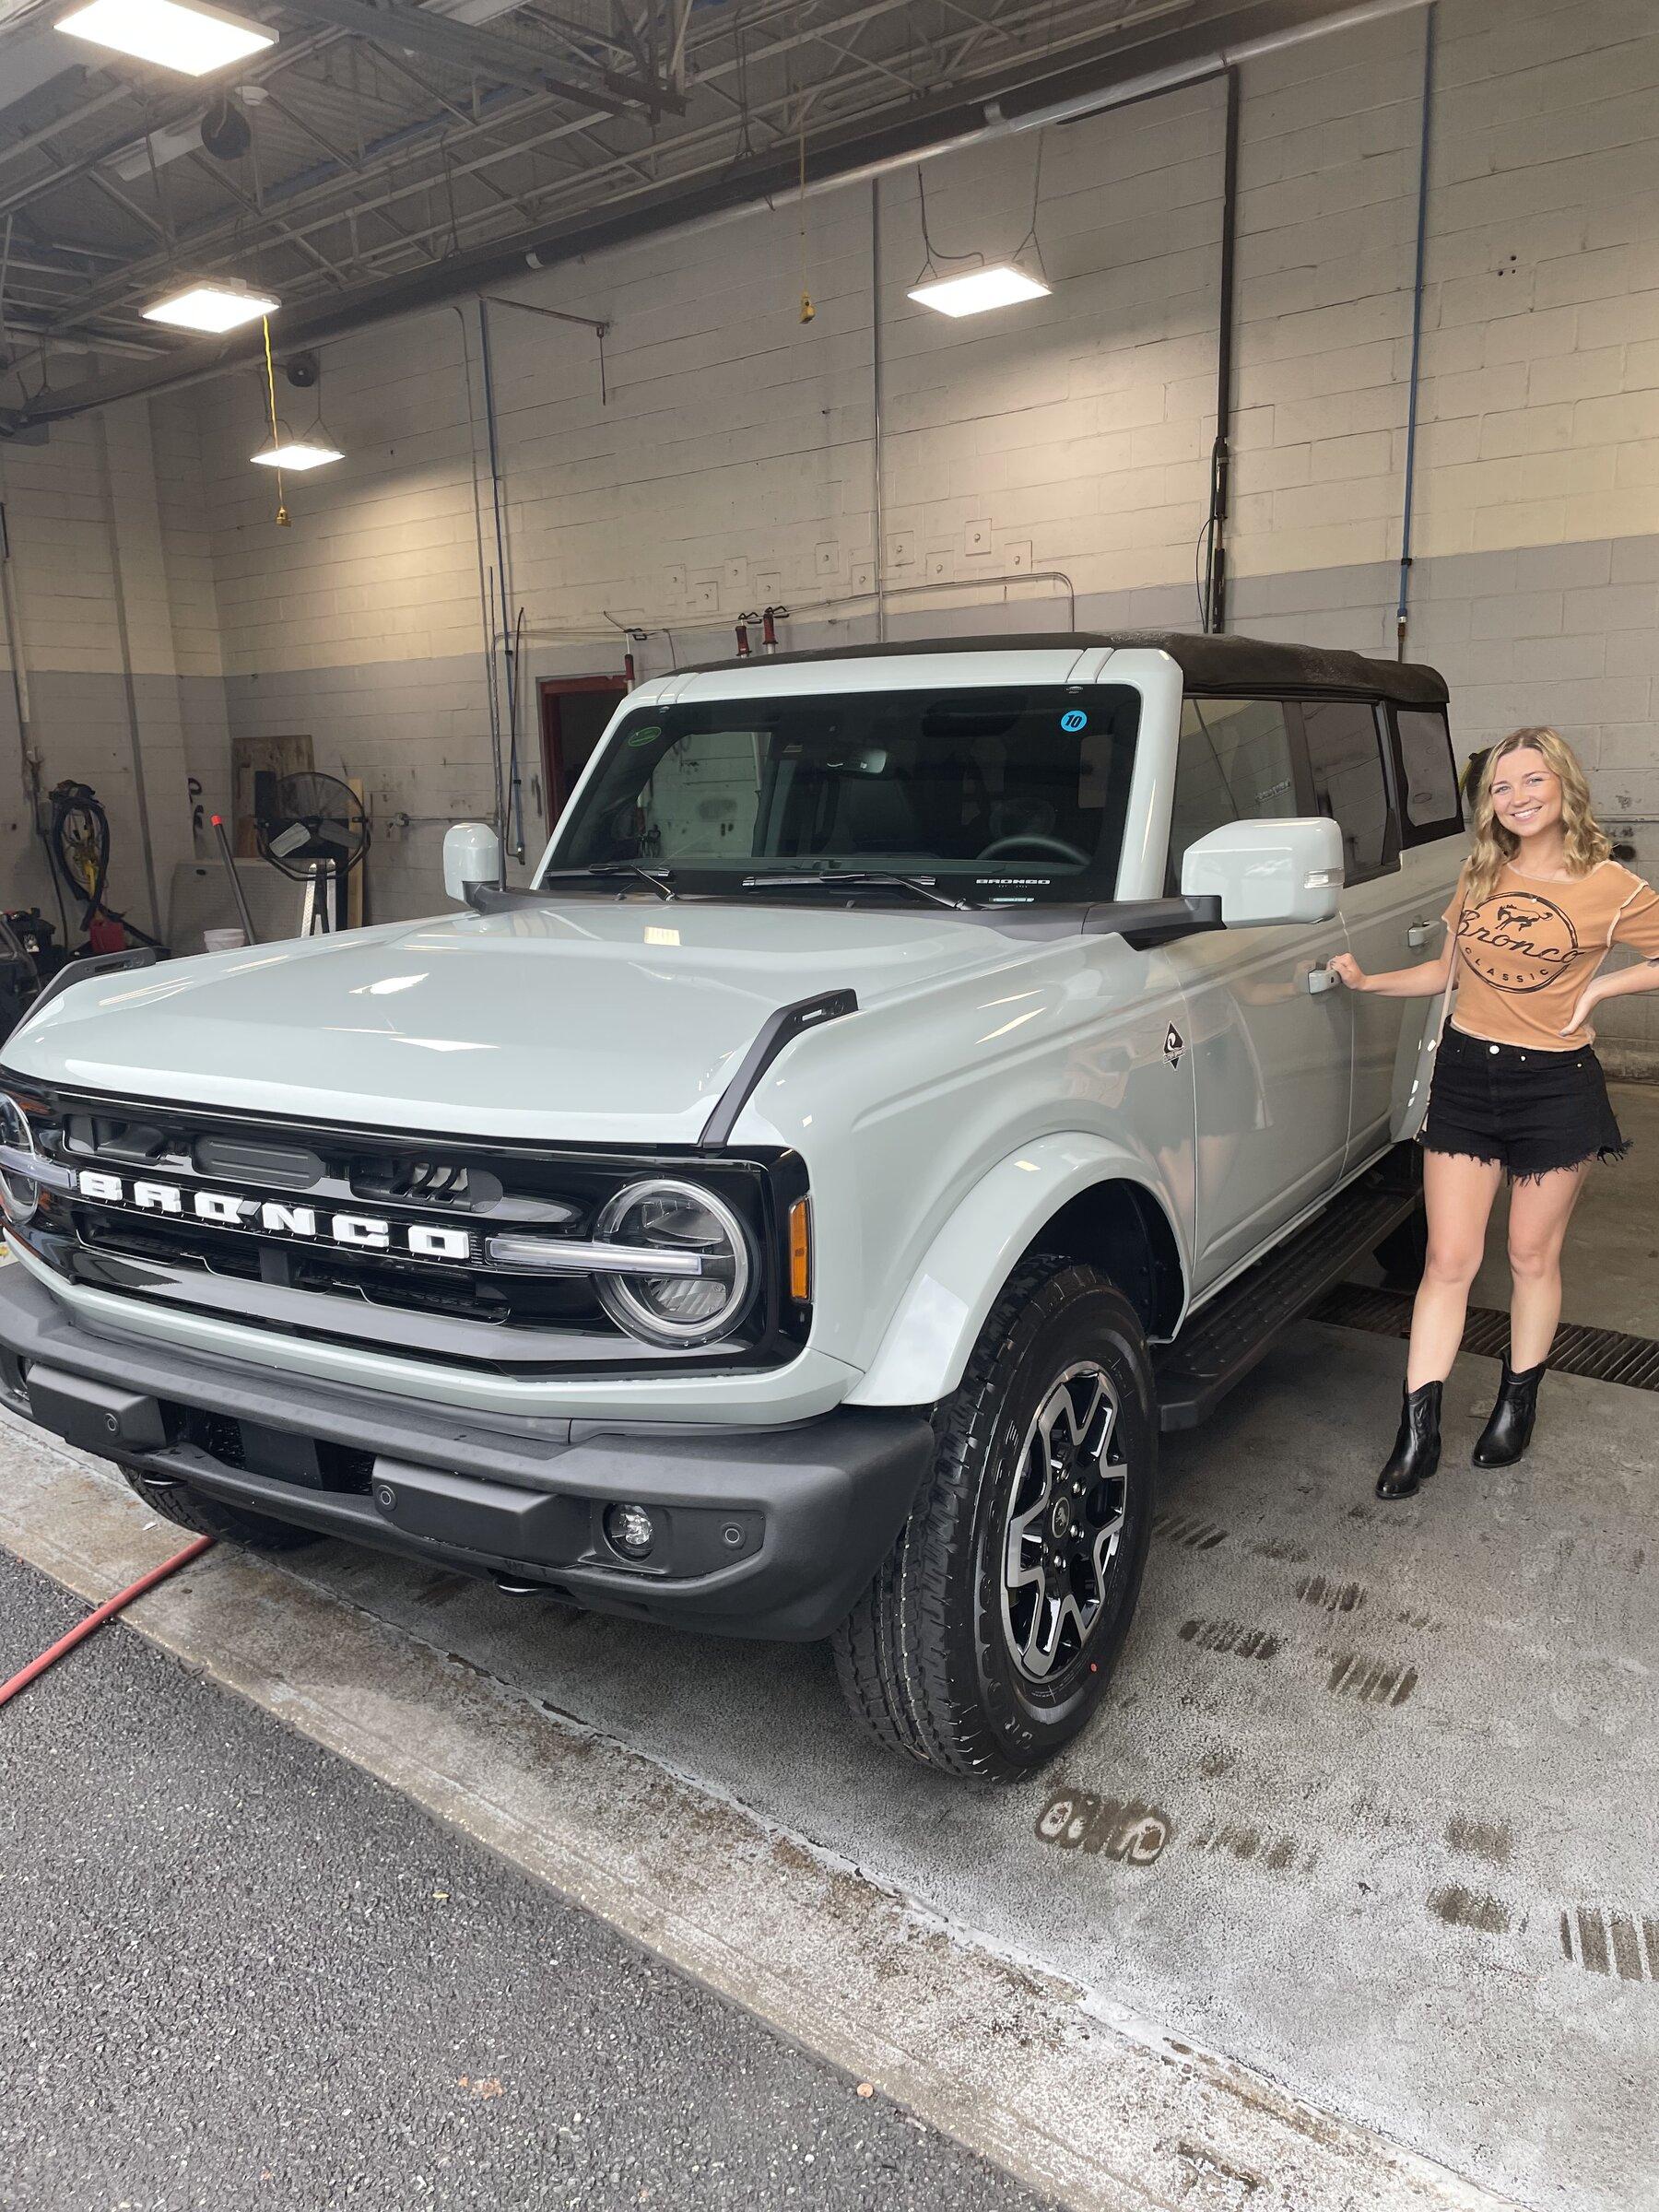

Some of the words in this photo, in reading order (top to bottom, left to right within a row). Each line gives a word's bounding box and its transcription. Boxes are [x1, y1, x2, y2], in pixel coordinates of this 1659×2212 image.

[1065, 714, 1083, 728] 10
[1457, 909, 1585, 964] Bronco
[1465, 947, 1550, 982] CLASSIC
[79, 1171, 469, 1259] BRONCO
